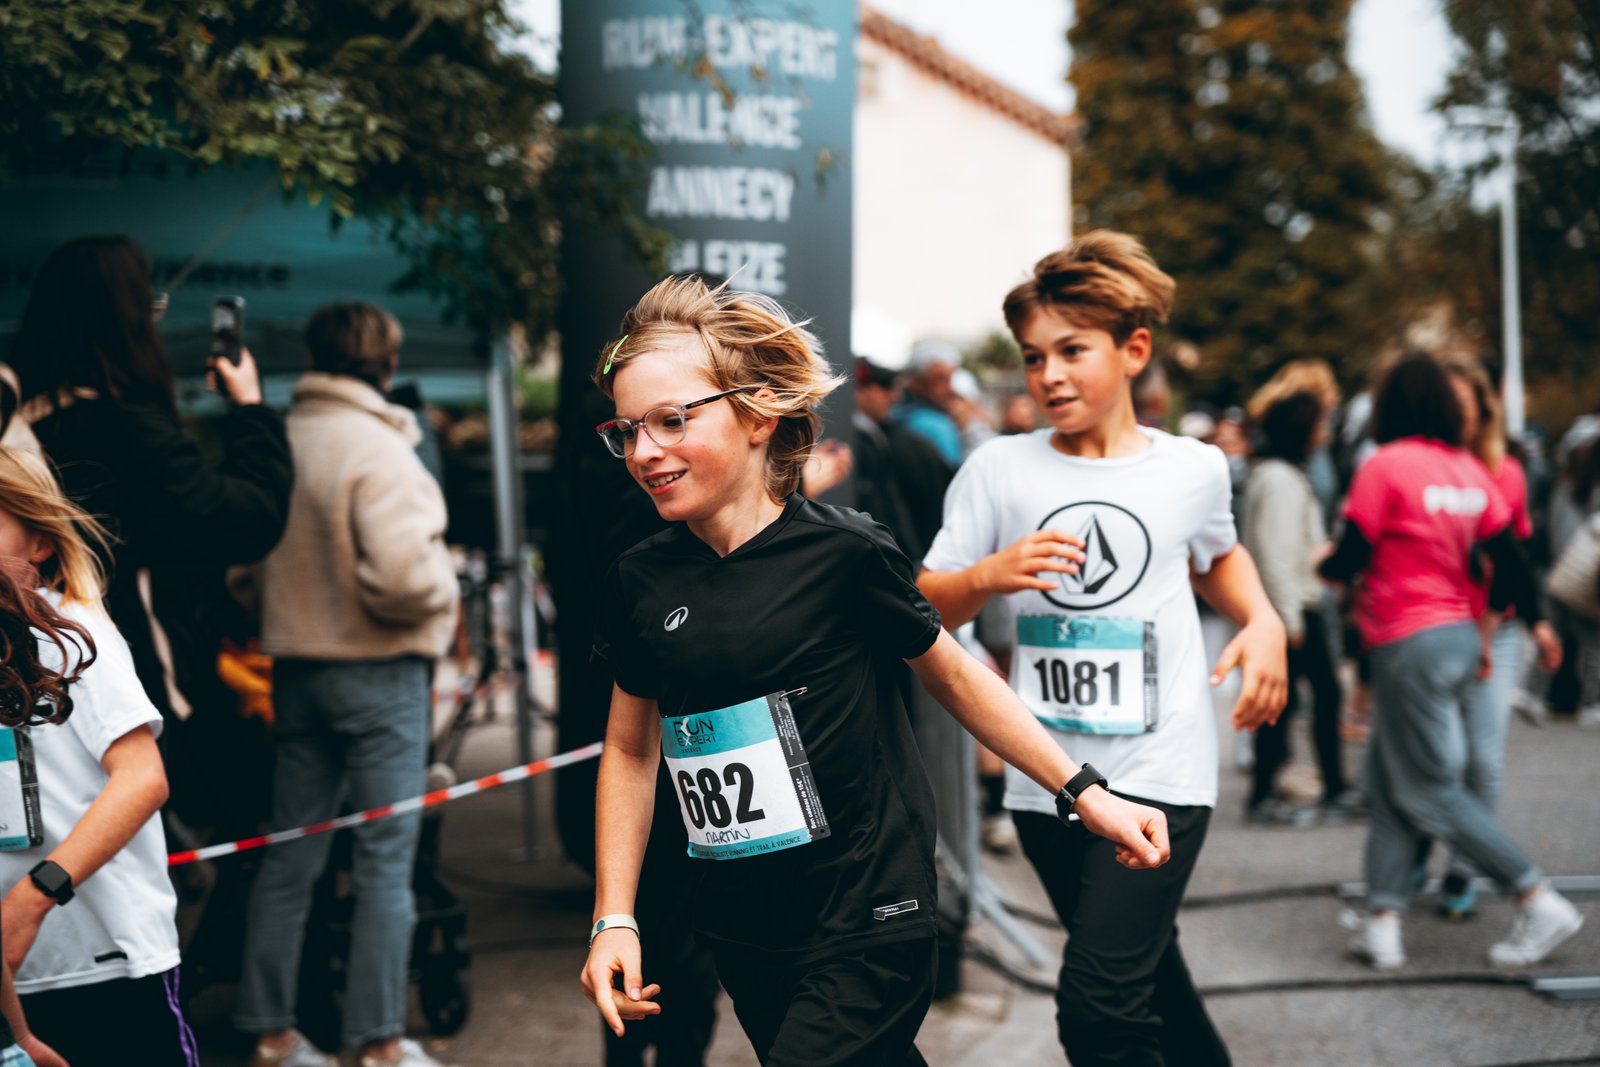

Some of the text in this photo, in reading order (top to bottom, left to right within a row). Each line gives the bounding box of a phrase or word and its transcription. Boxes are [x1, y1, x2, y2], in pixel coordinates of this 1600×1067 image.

[638, 93, 801, 148] VALENCE
[648, 168, 796, 222] ANNECY
[1034, 658, 1120, 705] 1081
[673, 719, 714, 738] RUN
[678, 736, 716, 747] EXPERT
[677, 762, 766, 829] 682
[757, 844, 770, 852] TRAIL
[776, 836, 801, 847] VALENCE
